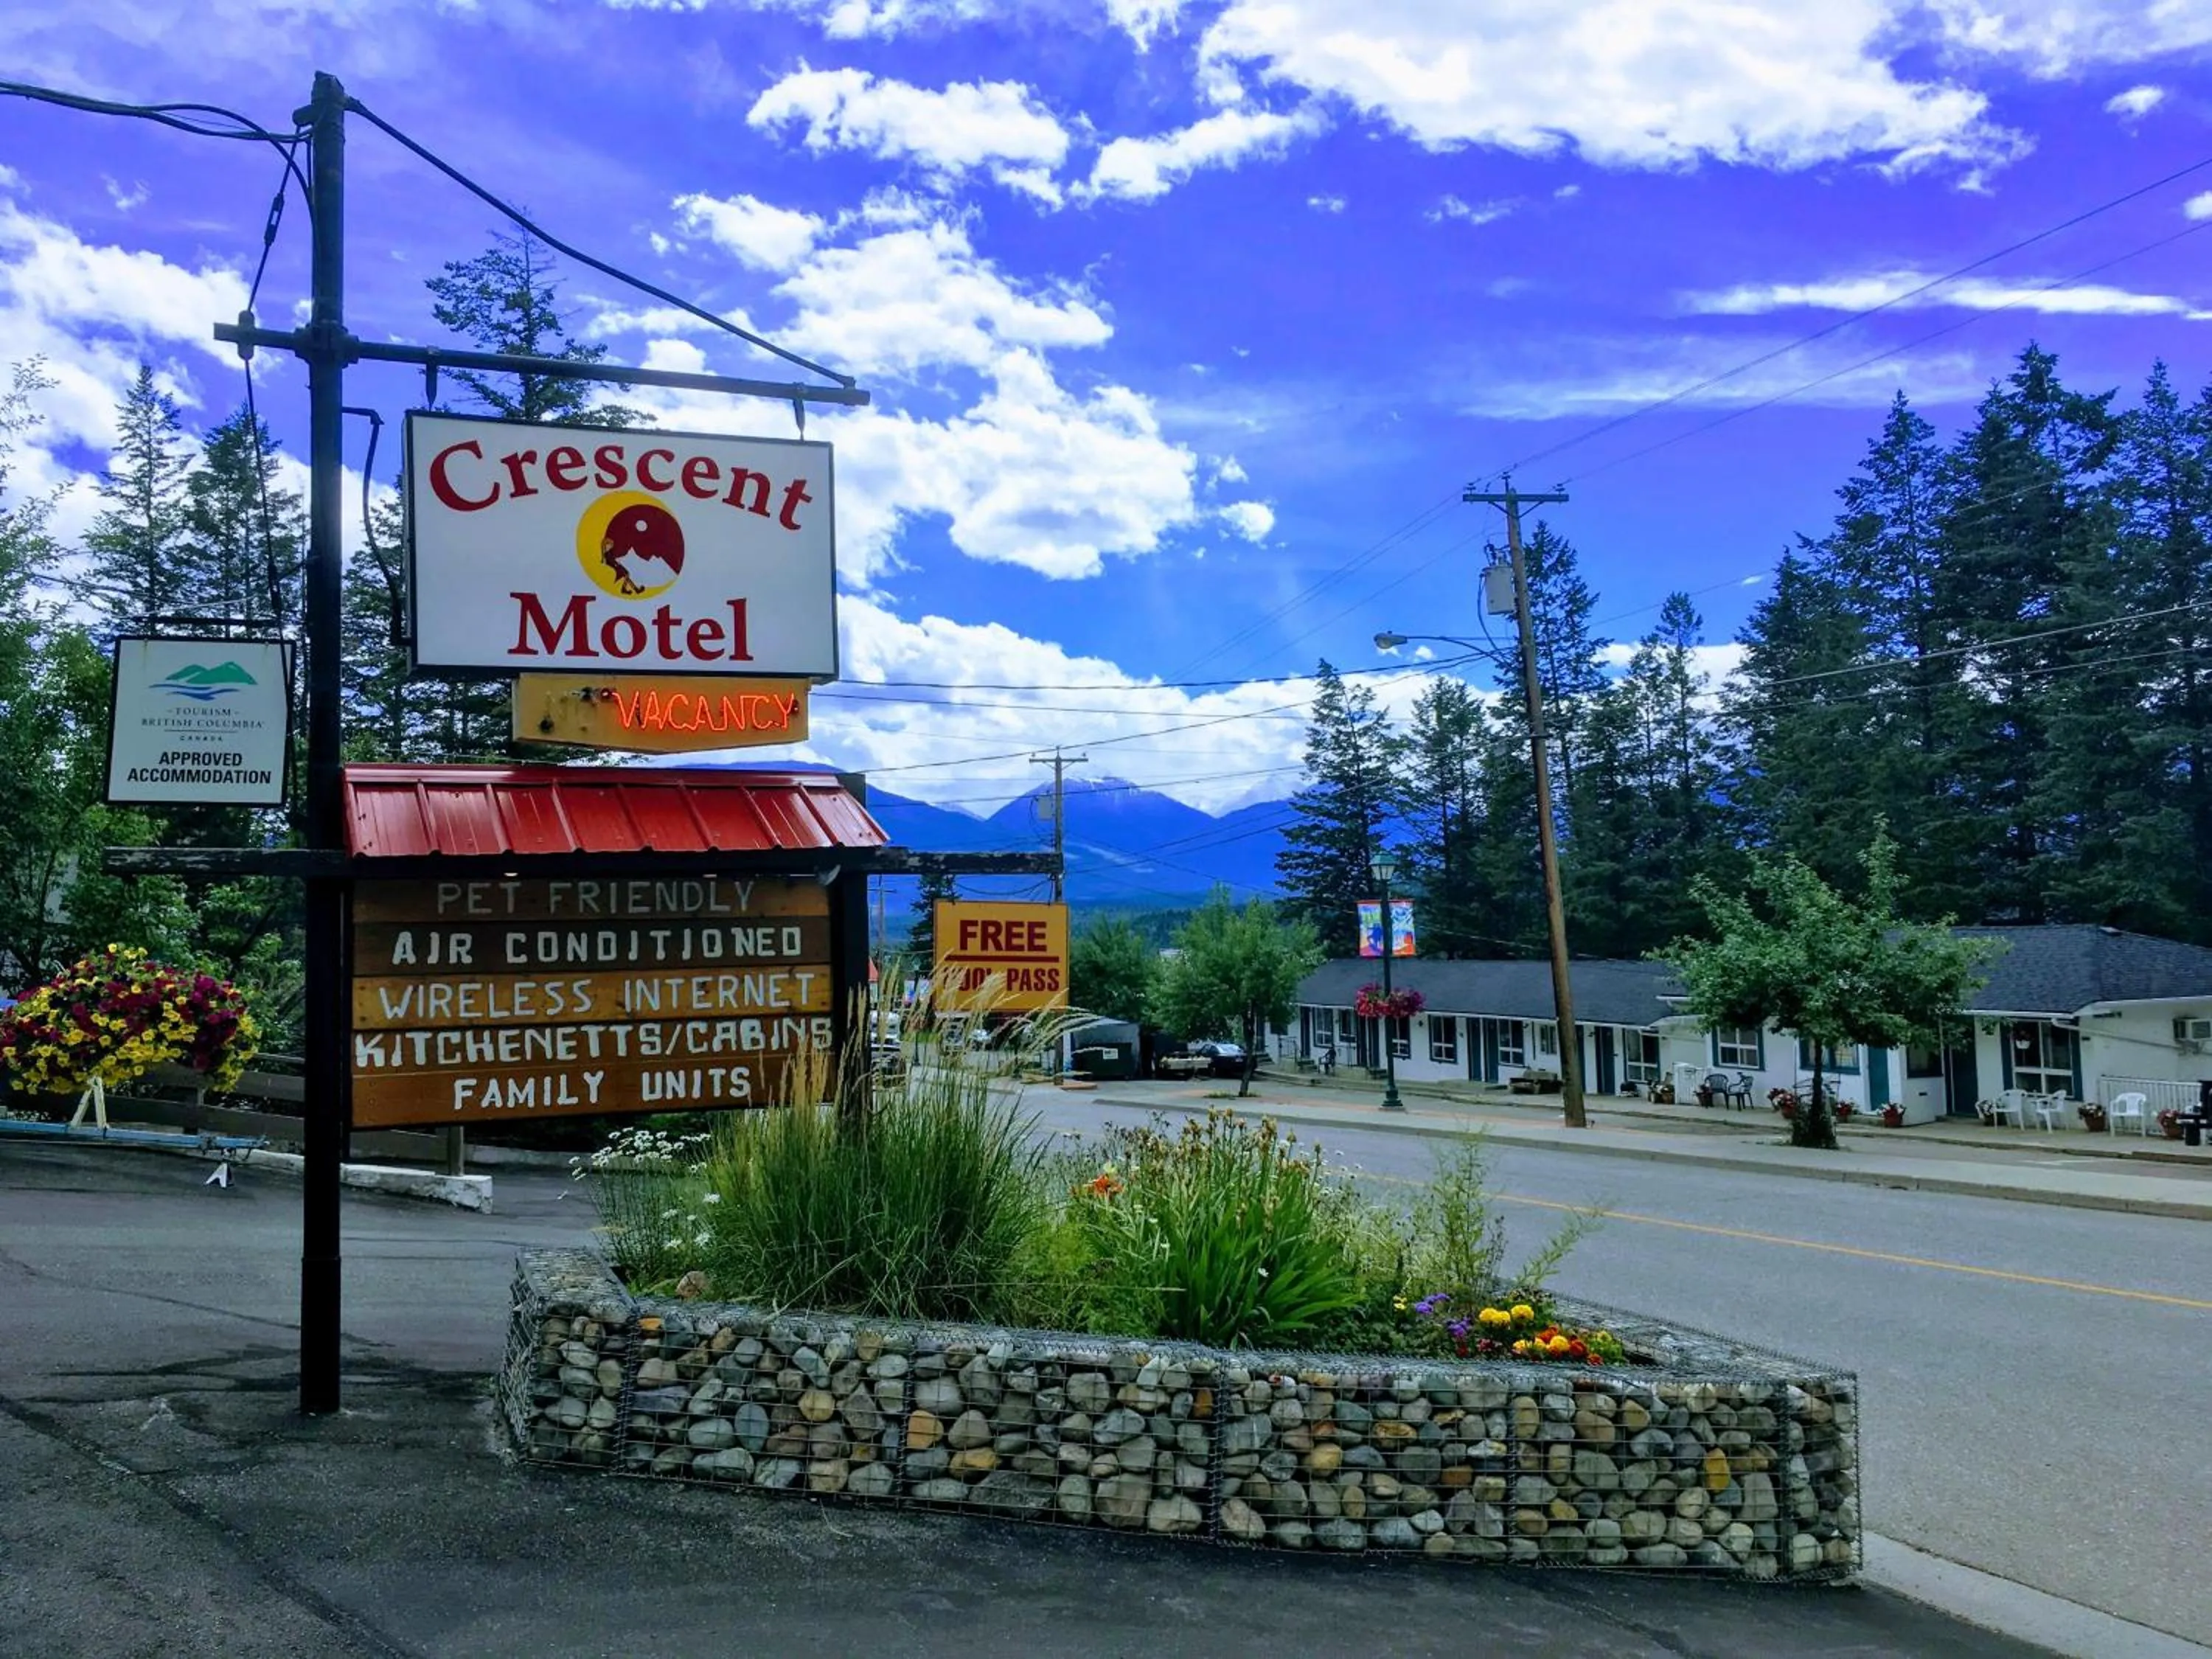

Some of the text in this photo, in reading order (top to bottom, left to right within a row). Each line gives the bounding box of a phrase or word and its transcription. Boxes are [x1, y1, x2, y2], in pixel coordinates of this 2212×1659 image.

[429, 439, 813, 530] Crescent
[507, 591, 754, 661] Motel
[142, 718, 262, 728] BRITISH COLUMBIA
[175, 708, 232, 716] TOURISM
[611, 691, 796, 731] VACANCY
[127, 768, 271, 785] ACCOMMODATION
[159, 751, 243, 767] APPROVED
[437, 880, 755, 915] PET FRIENDLY
[392, 927, 802, 965] AIR CONDITIONED
[959, 919, 1047, 952] FREE
[378, 973, 815, 1020] WIRELESS INTERNET
[1006, 967, 1060, 992] PASS
[355, 1017, 832, 1068] KITCHENETTS/CABINS
[453, 1067, 751, 1110] FAMILY UNITS
